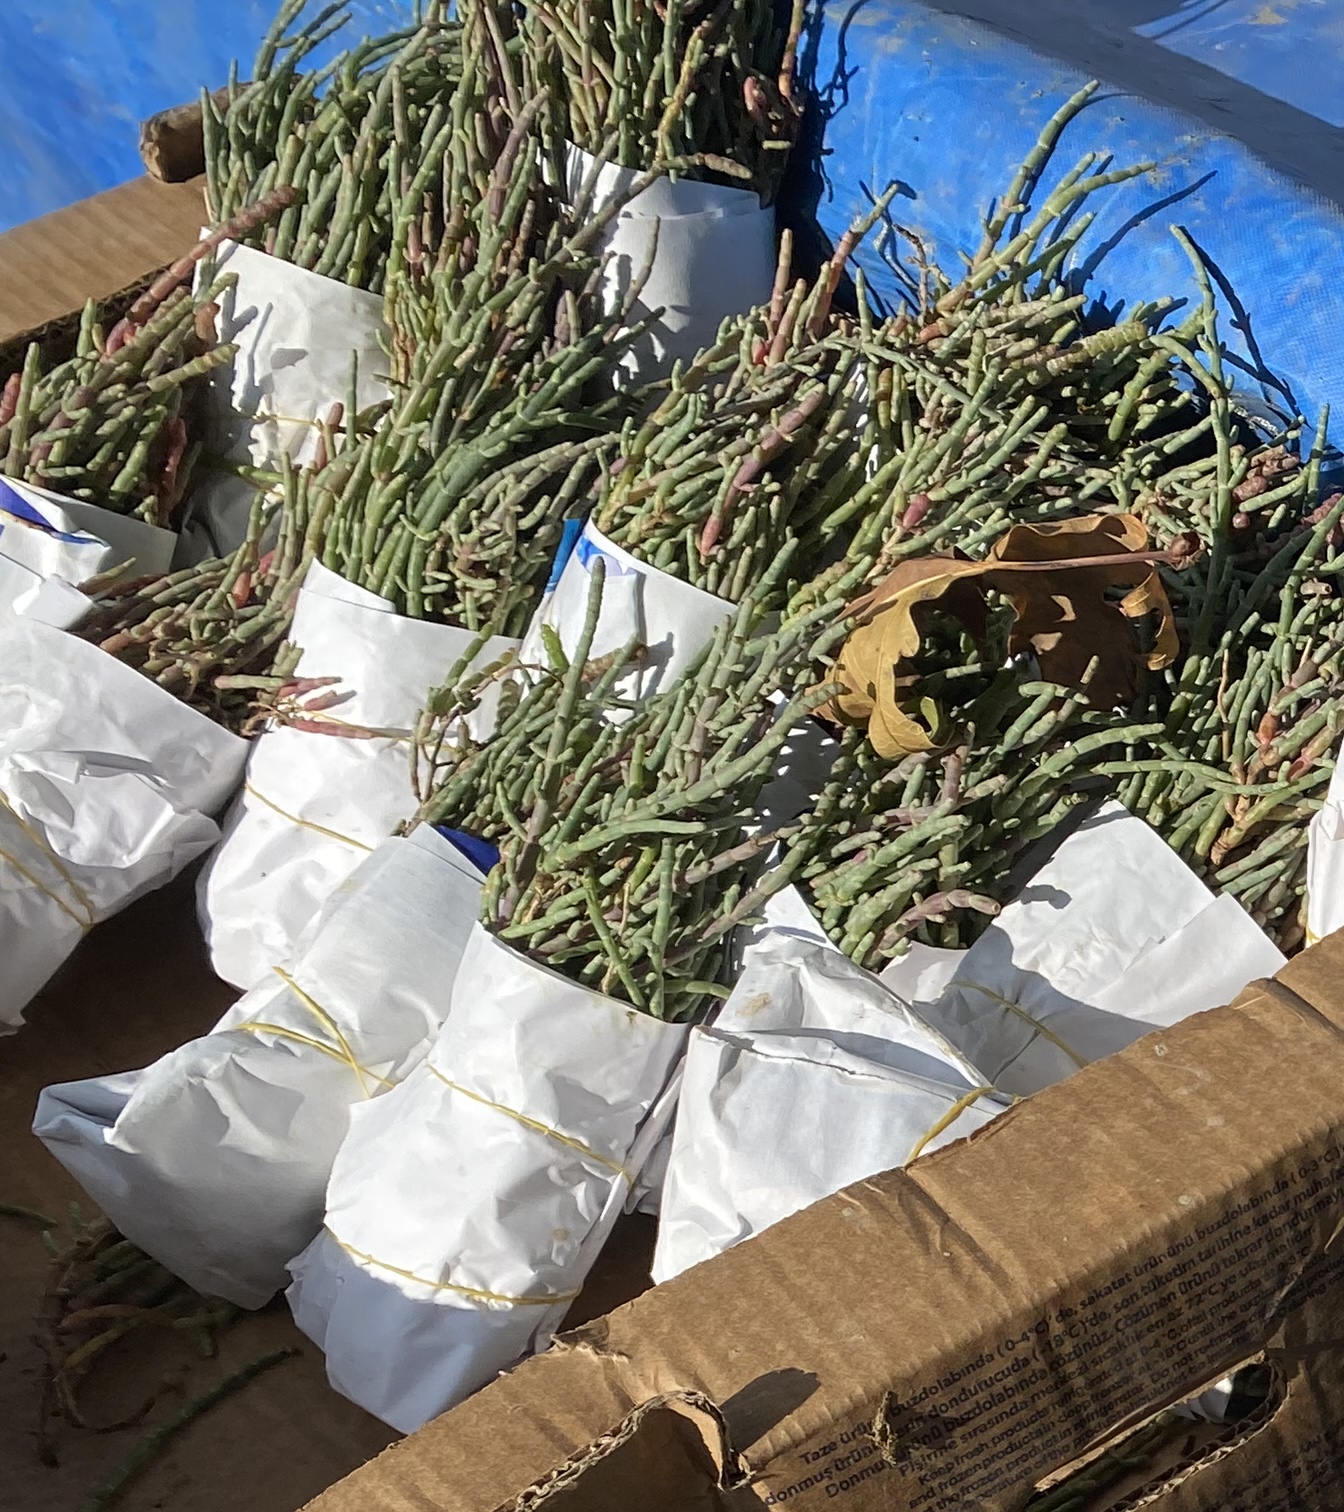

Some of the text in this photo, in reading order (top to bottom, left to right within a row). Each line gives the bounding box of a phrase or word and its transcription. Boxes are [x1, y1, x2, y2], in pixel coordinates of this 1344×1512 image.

[765, 1467, 833, 1505] donmuş
[928, 1357, 1030, 1419] dondurucuda
[1113, 1292, 1140, 1314] son
[1140, 1258, 1197, 1296] tüketim
[1197, 1225, 1251, 1262] tarihine
[1252, 1200, 1290, 1227] kadar
[799, 1441, 838, 1465] Taze
[887, 1353, 995, 1417] buzdolabında
[1079, 1272, 1132, 1310] sakatat
[1133, 1234, 1194, 1277] ürününü
[1194, 1180, 1289, 1241] buzdolabında
[823, 1451, 892, 1499] Donmu
[942, 1368, 1047, 1432] buzdolabında
[1114, 1291, 1177, 1336] Çözünen
[1178, 1262, 1221, 1295] ürünü
[1221, 1237, 1262, 1269] tekrar
[898, 1436, 958, 1477] Pişirme
[959, 1400, 1029, 1444] sırasında
[1146, 1318, 1165, 1333] en
[1167, 1306, 1185, 1322] az
[909, 1486, 936, 1510] and
[938, 1463, 982, 1493] frozen
[917, 1462, 954, 1486] Keep
[953, 1442, 990, 1466] fresh
[990, 1407, 1049, 1447] products
[936, 1493, 960, 1510] the
[959, 1467, 1004, 1497] frozen
[1149, 1367, 1170, 1384] Do
[1171, 1352, 1194, 1371] not
